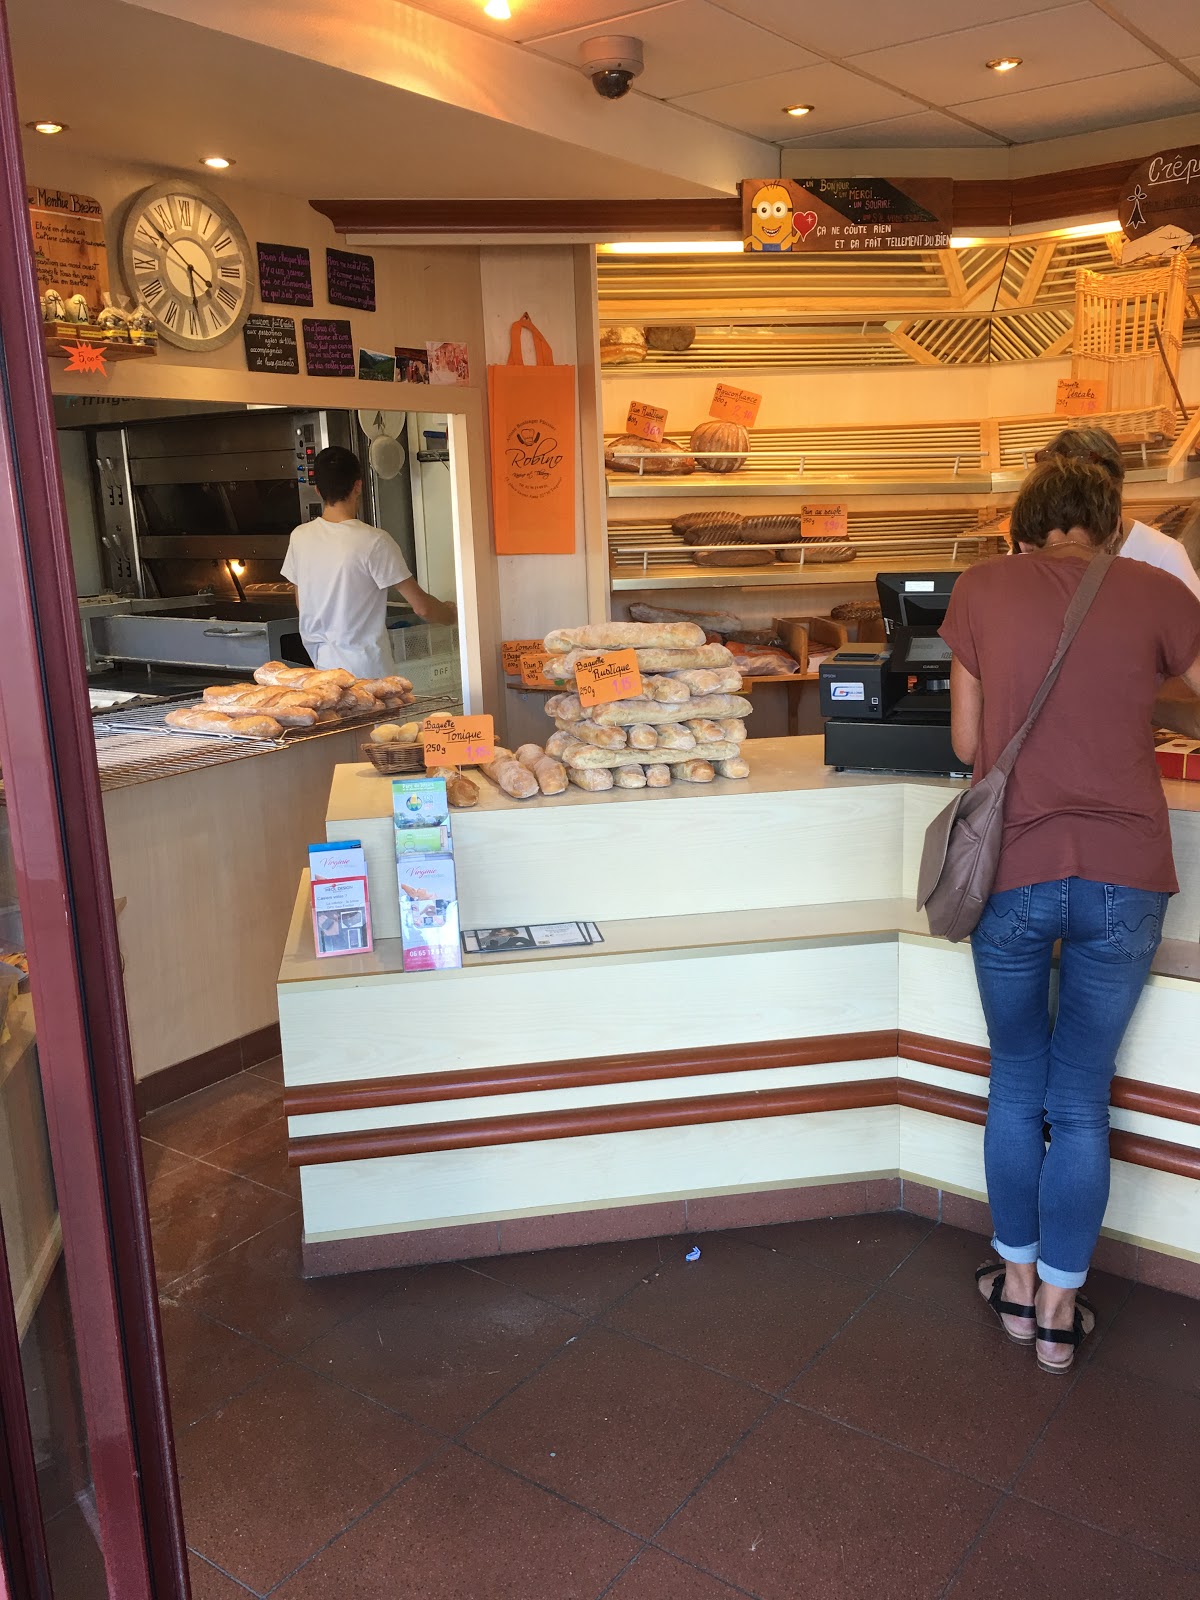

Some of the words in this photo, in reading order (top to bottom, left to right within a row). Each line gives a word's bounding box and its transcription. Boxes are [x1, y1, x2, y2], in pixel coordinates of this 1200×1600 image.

[1149, 155, 1200, 184] Crêp
[816, 226, 827, 237] ÇA
[831, 226, 840, 235] NE
[844, 223, 867, 235] COÛTE
[835, 239, 845, 249] ET
[885, 235, 924, 247] TELLEMENT
[924, 235, 934, 246] DU
[505, 437, 564, 469] Robino
[592, 663, 632, 680] Rustique
[443, 729, 483, 744] Tonique
[426, 744, 446, 755] 250g
